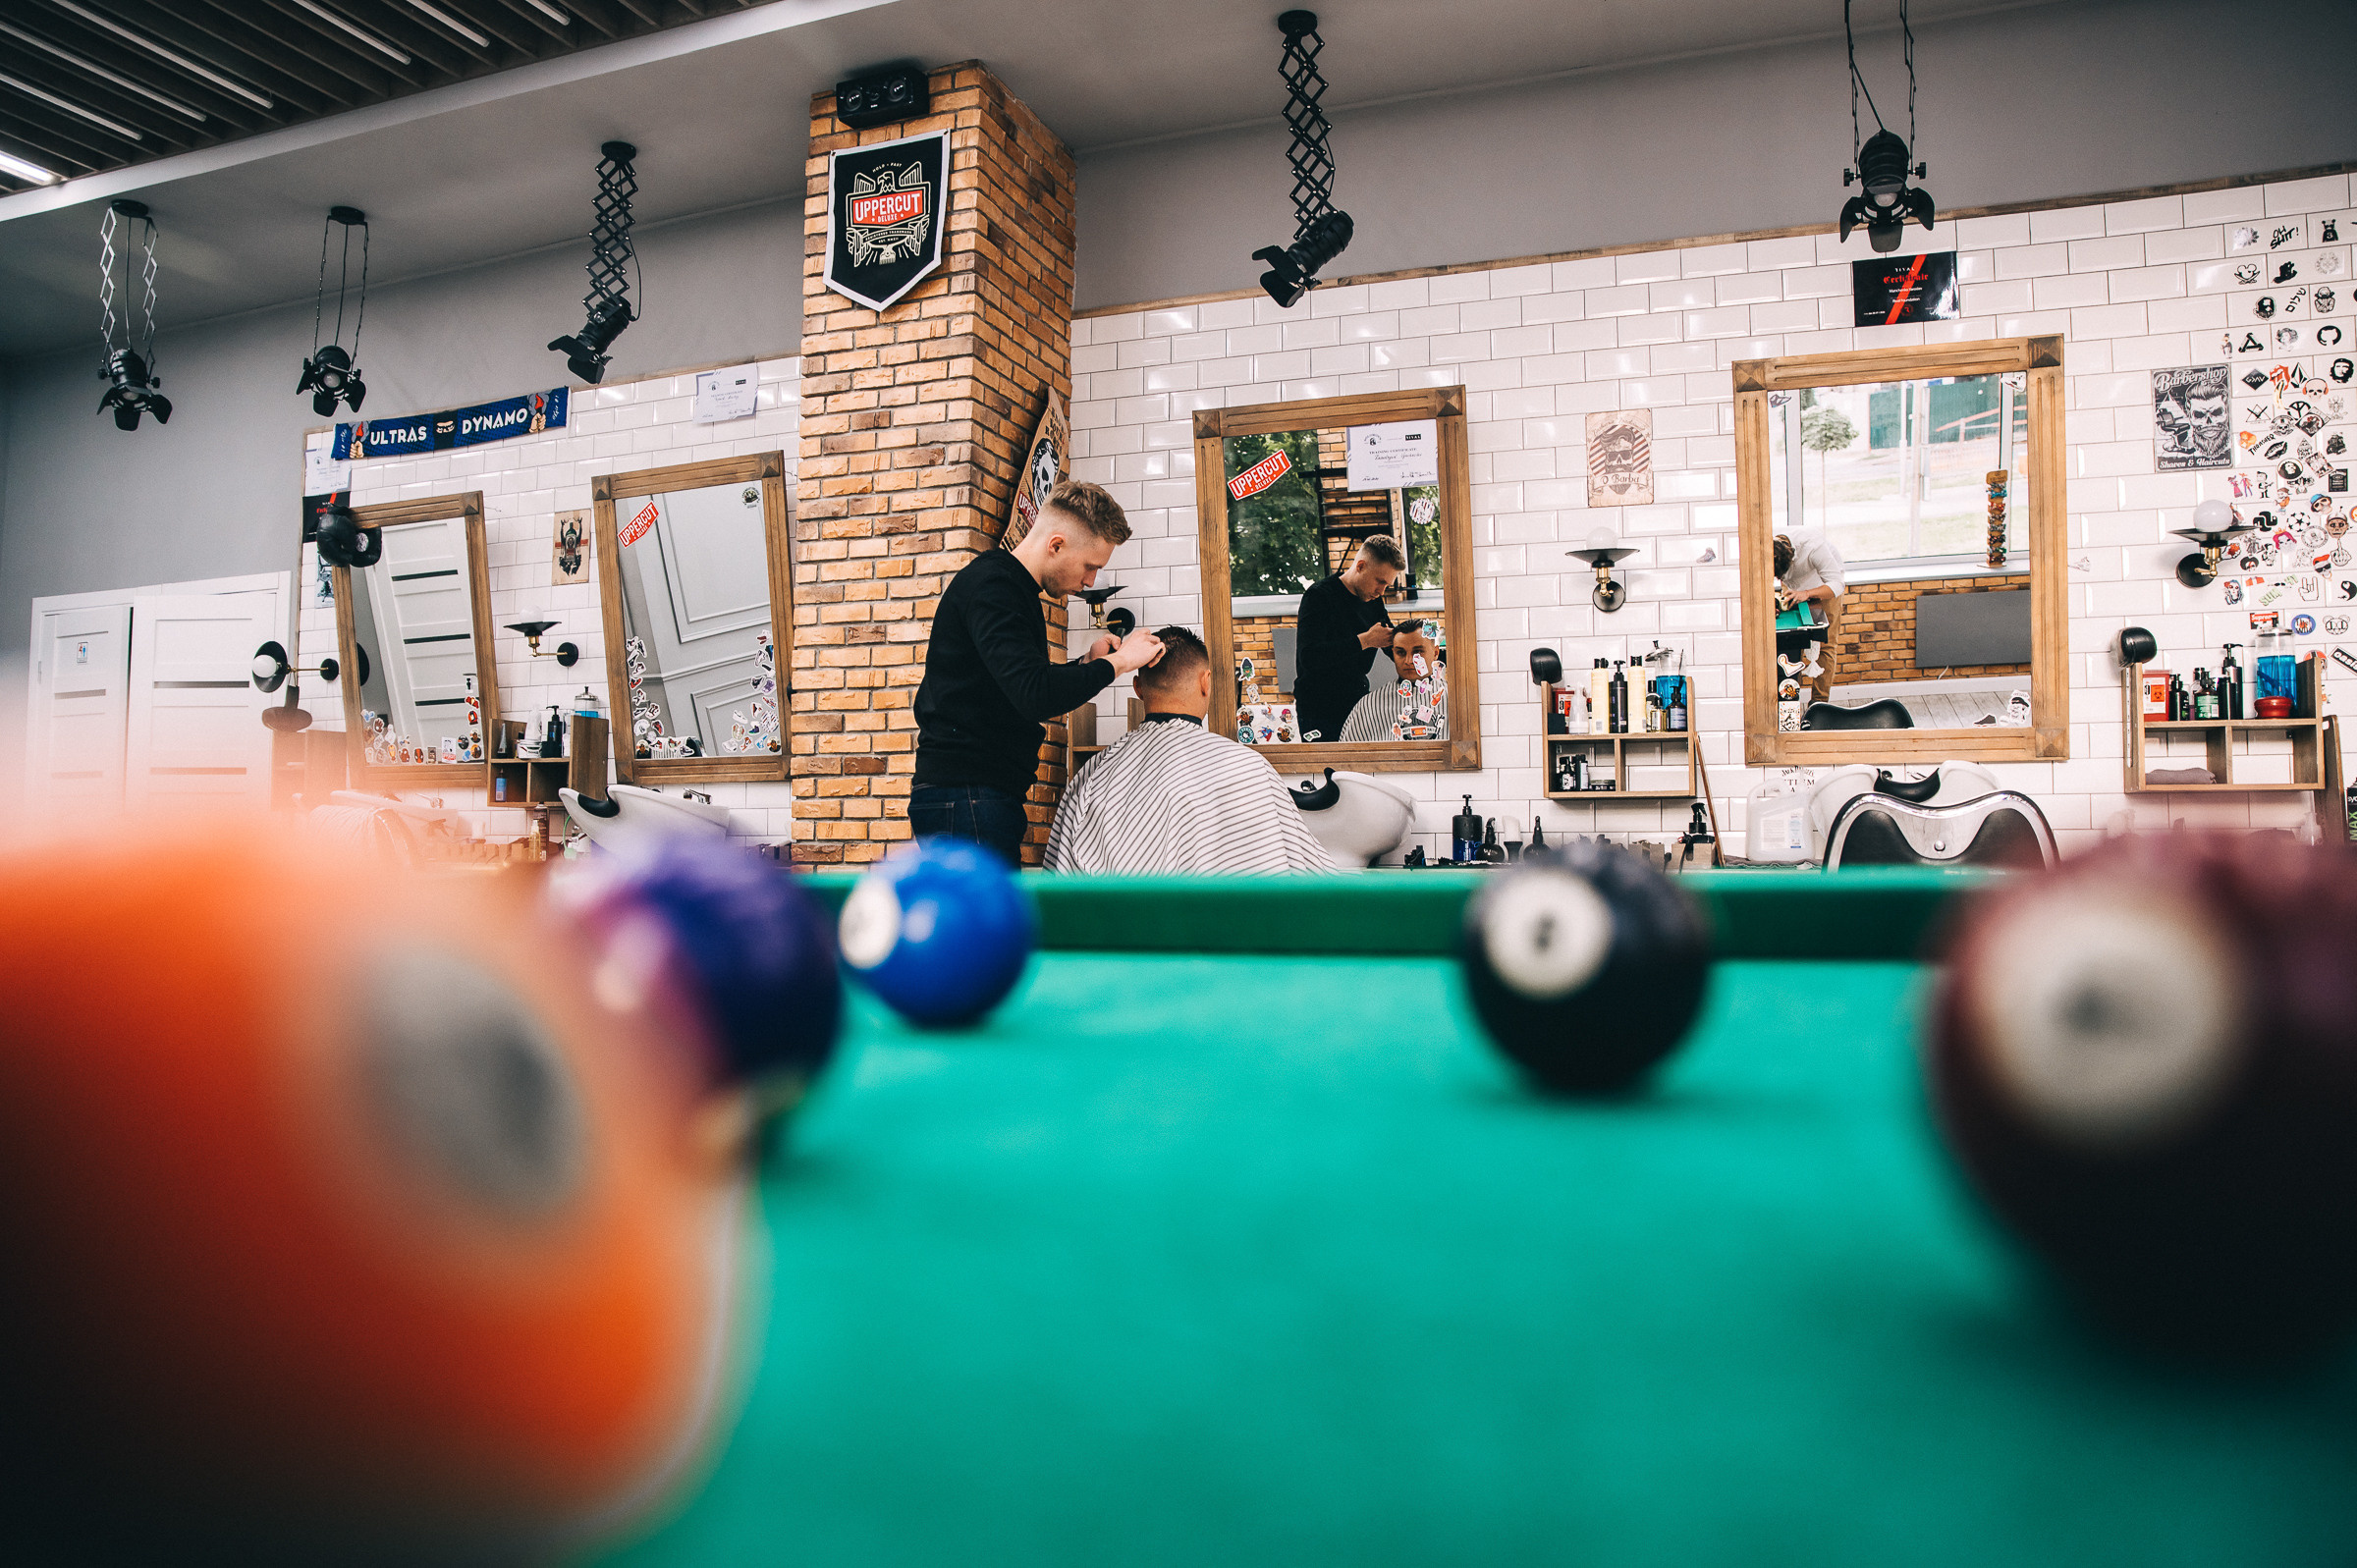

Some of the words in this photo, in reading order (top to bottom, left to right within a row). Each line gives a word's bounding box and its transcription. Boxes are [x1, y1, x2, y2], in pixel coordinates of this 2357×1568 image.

[854, 193, 920, 222] UPPERCUT
[877, 213, 898, 223] DELUXE
[2273, 225, 2287, 239] OH
[2155, 367, 2227, 393] Barbershop
[369, 425, 428, 446] ULTRAS
[462, 407, 528, 435] DYNAMO
[2248, 433, 2275, 456] THRASHER
[2196, 457, 2230, 466] Haircuts
[1230, 453, 1288, 497] UPPERCUT
[619, 504, 657, 546] UPPERCUT
[2259, 588, 2283, 606] SUM
